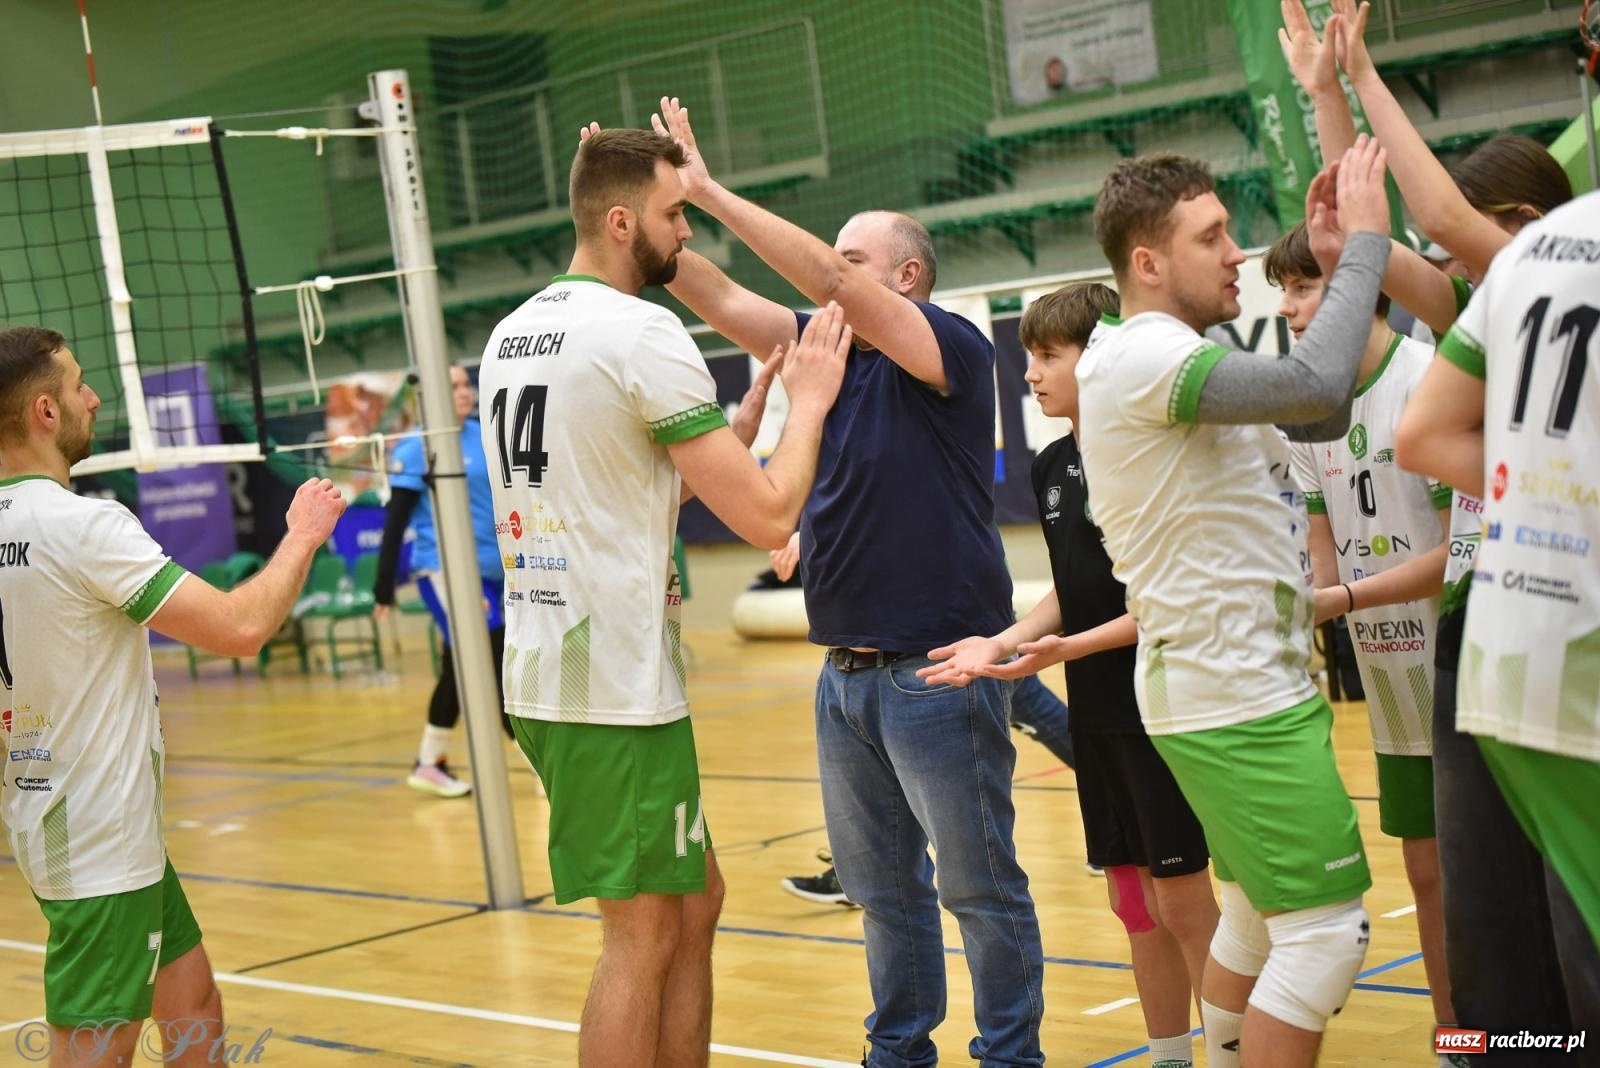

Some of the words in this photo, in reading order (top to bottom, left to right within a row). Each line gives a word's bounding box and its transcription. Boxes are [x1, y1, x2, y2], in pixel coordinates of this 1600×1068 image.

[498, 332, 566, 361] GERLICH
[1509, 297, 1600, 440] 11
[490, 384, 549, 488] 14
[1349, 469, 1377, 518] 10
[1354, 619, 1425, 640] PIVEXIN
[1359, 639, 1426, 653] TECHNOLOGY
